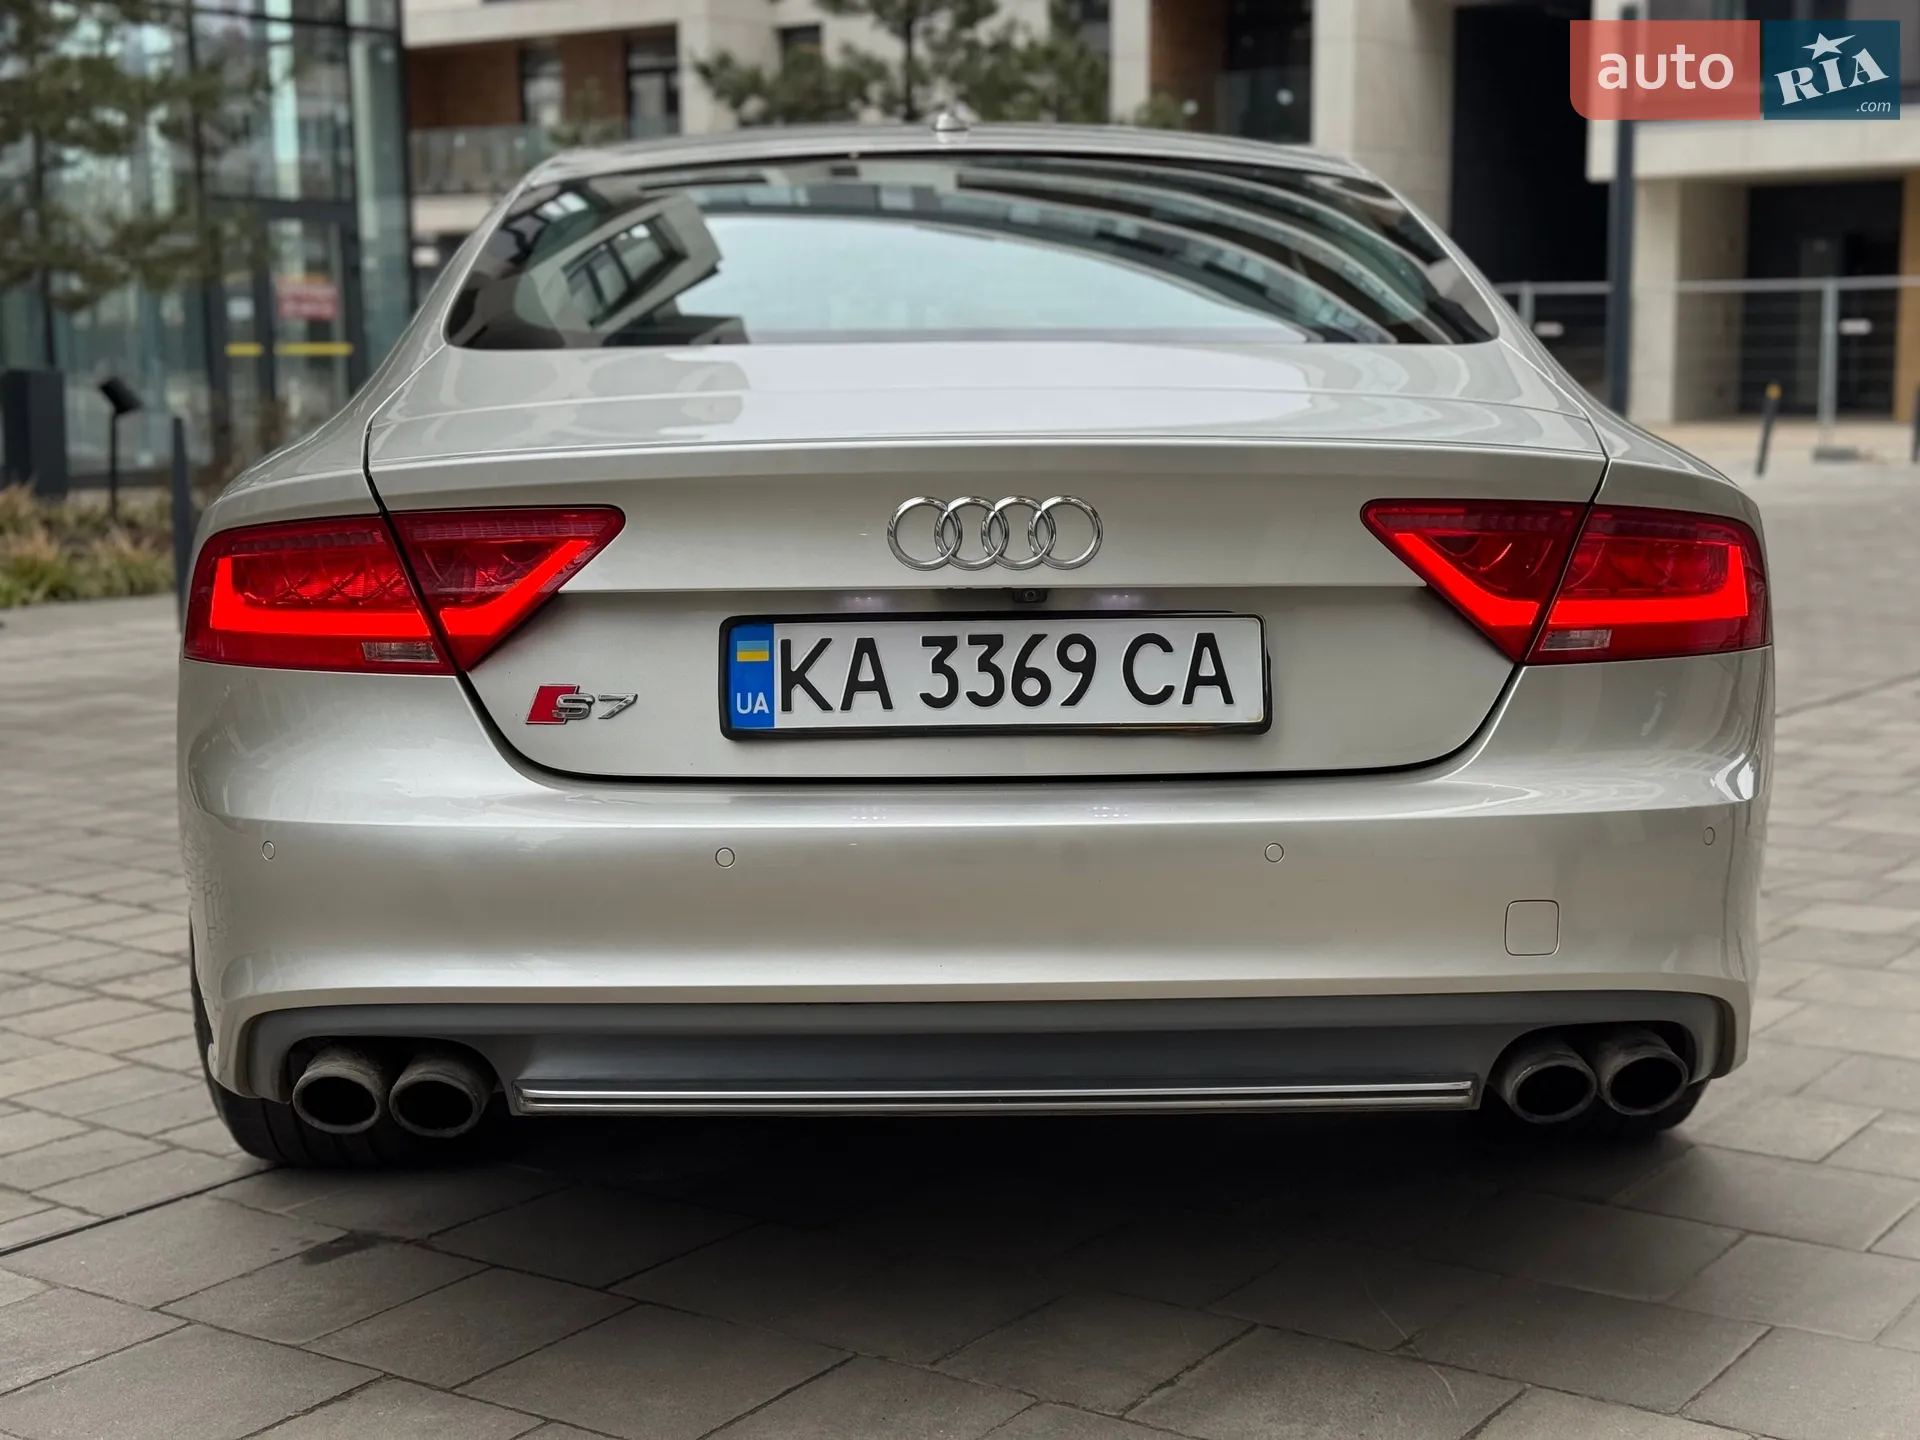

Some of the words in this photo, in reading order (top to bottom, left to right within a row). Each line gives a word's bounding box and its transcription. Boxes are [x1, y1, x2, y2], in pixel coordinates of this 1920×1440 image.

[780, 636, 894, 713] KA
[918, 632, 1098, 708] 3369
[1121, 631, 1235, 706] CA
[551, 692, 639, 721] S7
[736, 691, 770, 715] UA
